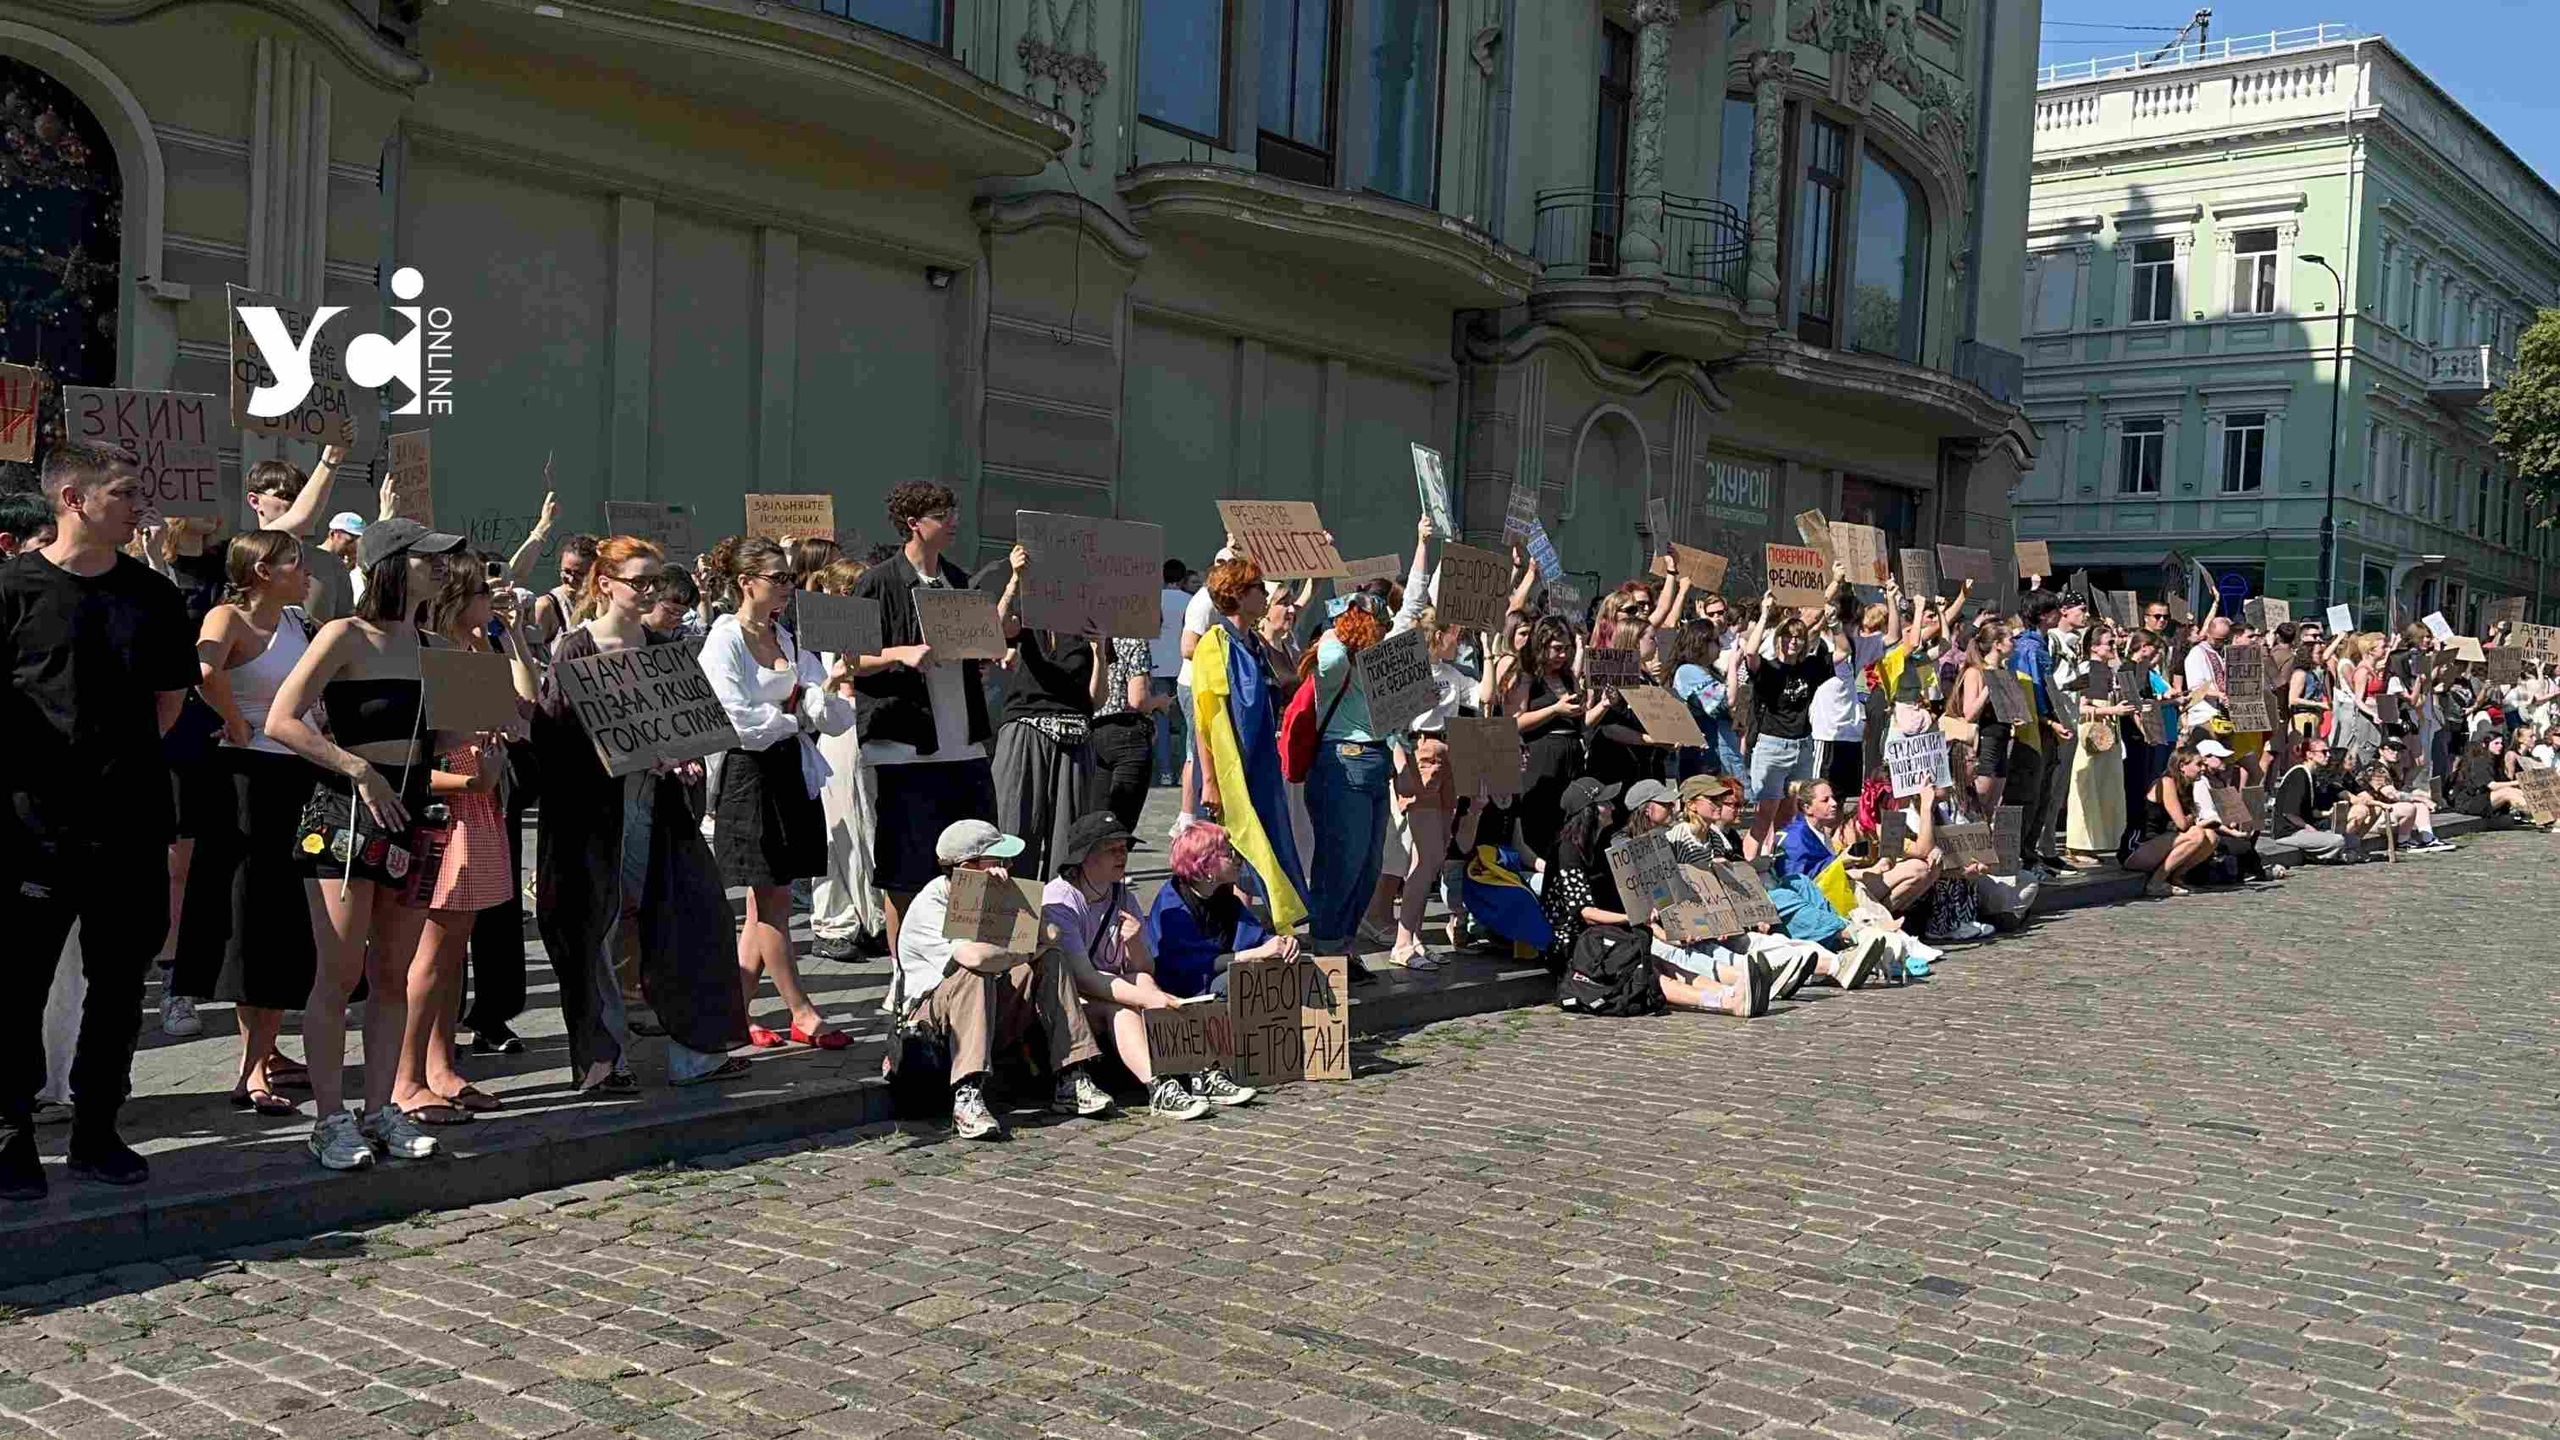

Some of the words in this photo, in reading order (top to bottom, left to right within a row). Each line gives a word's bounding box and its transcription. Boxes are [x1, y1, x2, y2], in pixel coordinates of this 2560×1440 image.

[115, 393, 206, 444] КИМ
[1229, 505, 1294, 526] ФЕДОРОВ
[1243, 528, 1334, 572] МІНІСТР
[1768, 547, 1824, 570] ПОВЕРНІТЬ
[1768, 568, 1825, 591] ФЕДОРОВА
[570, 652, 640, 694] НАМ
[636, 642, 699, 679] ВСІМ
[653, 674, 713, 709] ЯКЩО
[594, 718, 671, 758] ГОЛОС
[1233, 1032, 1260, 1079] НЕ
[1258, 1016, 1346, 1076] ТРОГАЙ
